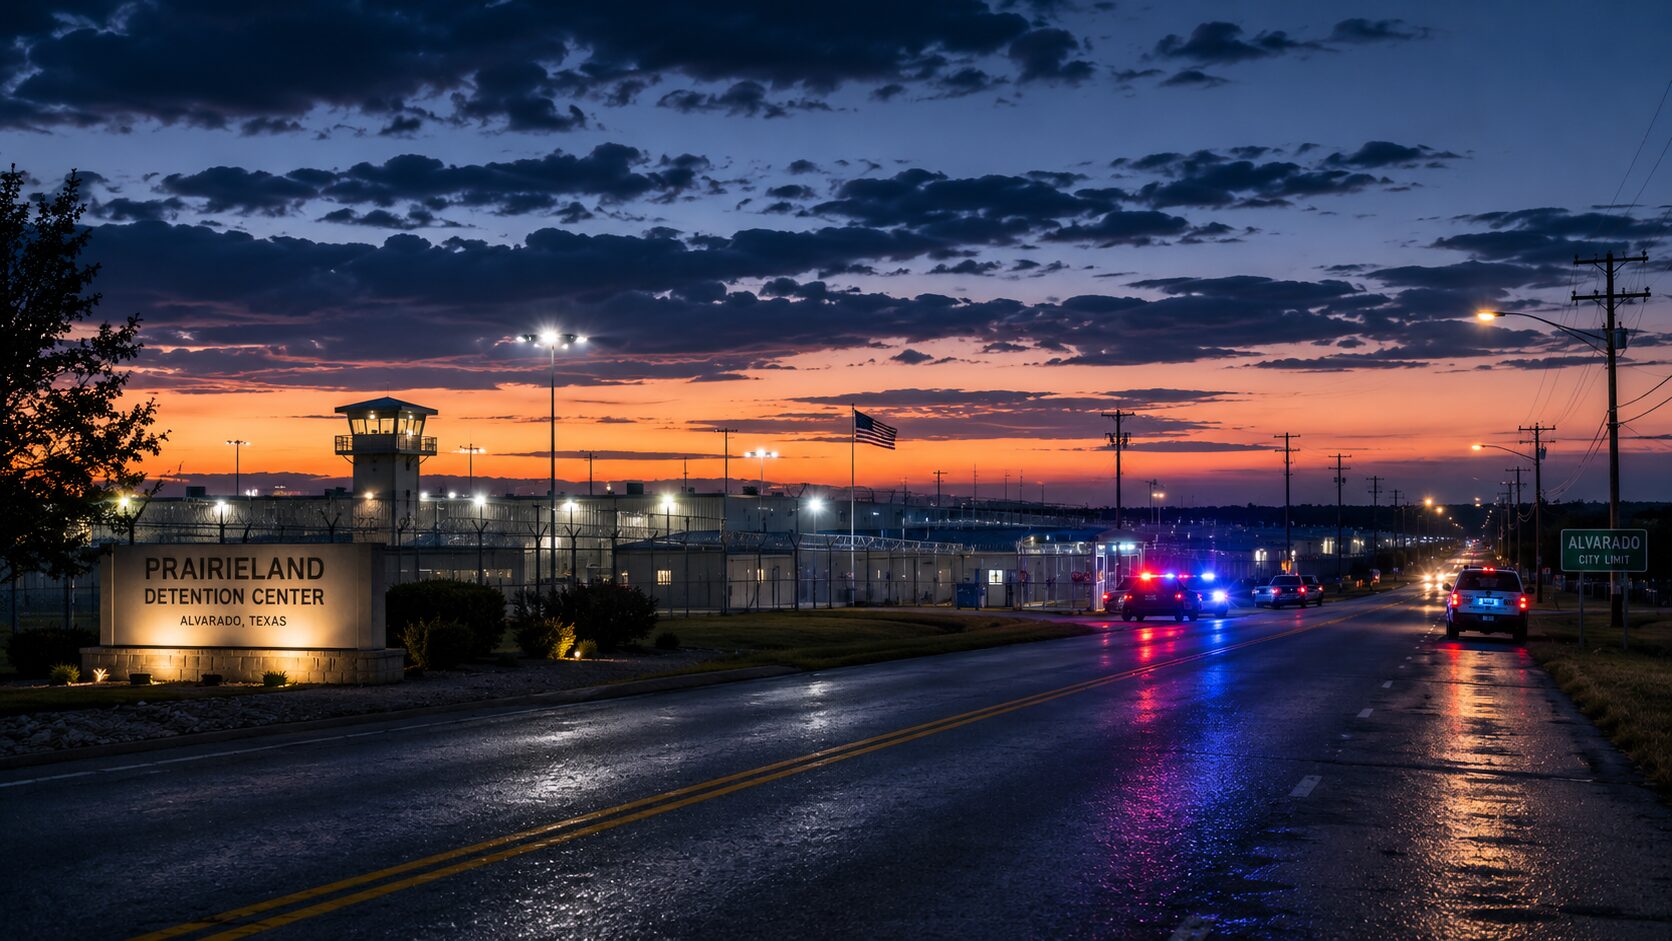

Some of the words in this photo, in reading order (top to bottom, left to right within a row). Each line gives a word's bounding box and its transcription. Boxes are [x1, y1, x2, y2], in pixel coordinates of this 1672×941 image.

[1568, 535, 1640, 550] ALVARADO
[1578, 554, 1600, 565] CITY
[1604, 554, 1630, 565] LIMIT
[145, 557, 325, 580] PRAIRIELAND
[144, 588, 245, 605] DETENTION
[251, 588, 325, 606] CENTER
[180, 615, 245, 628] ALVARADO,
[248, 615, 287, 627] TEXAS
